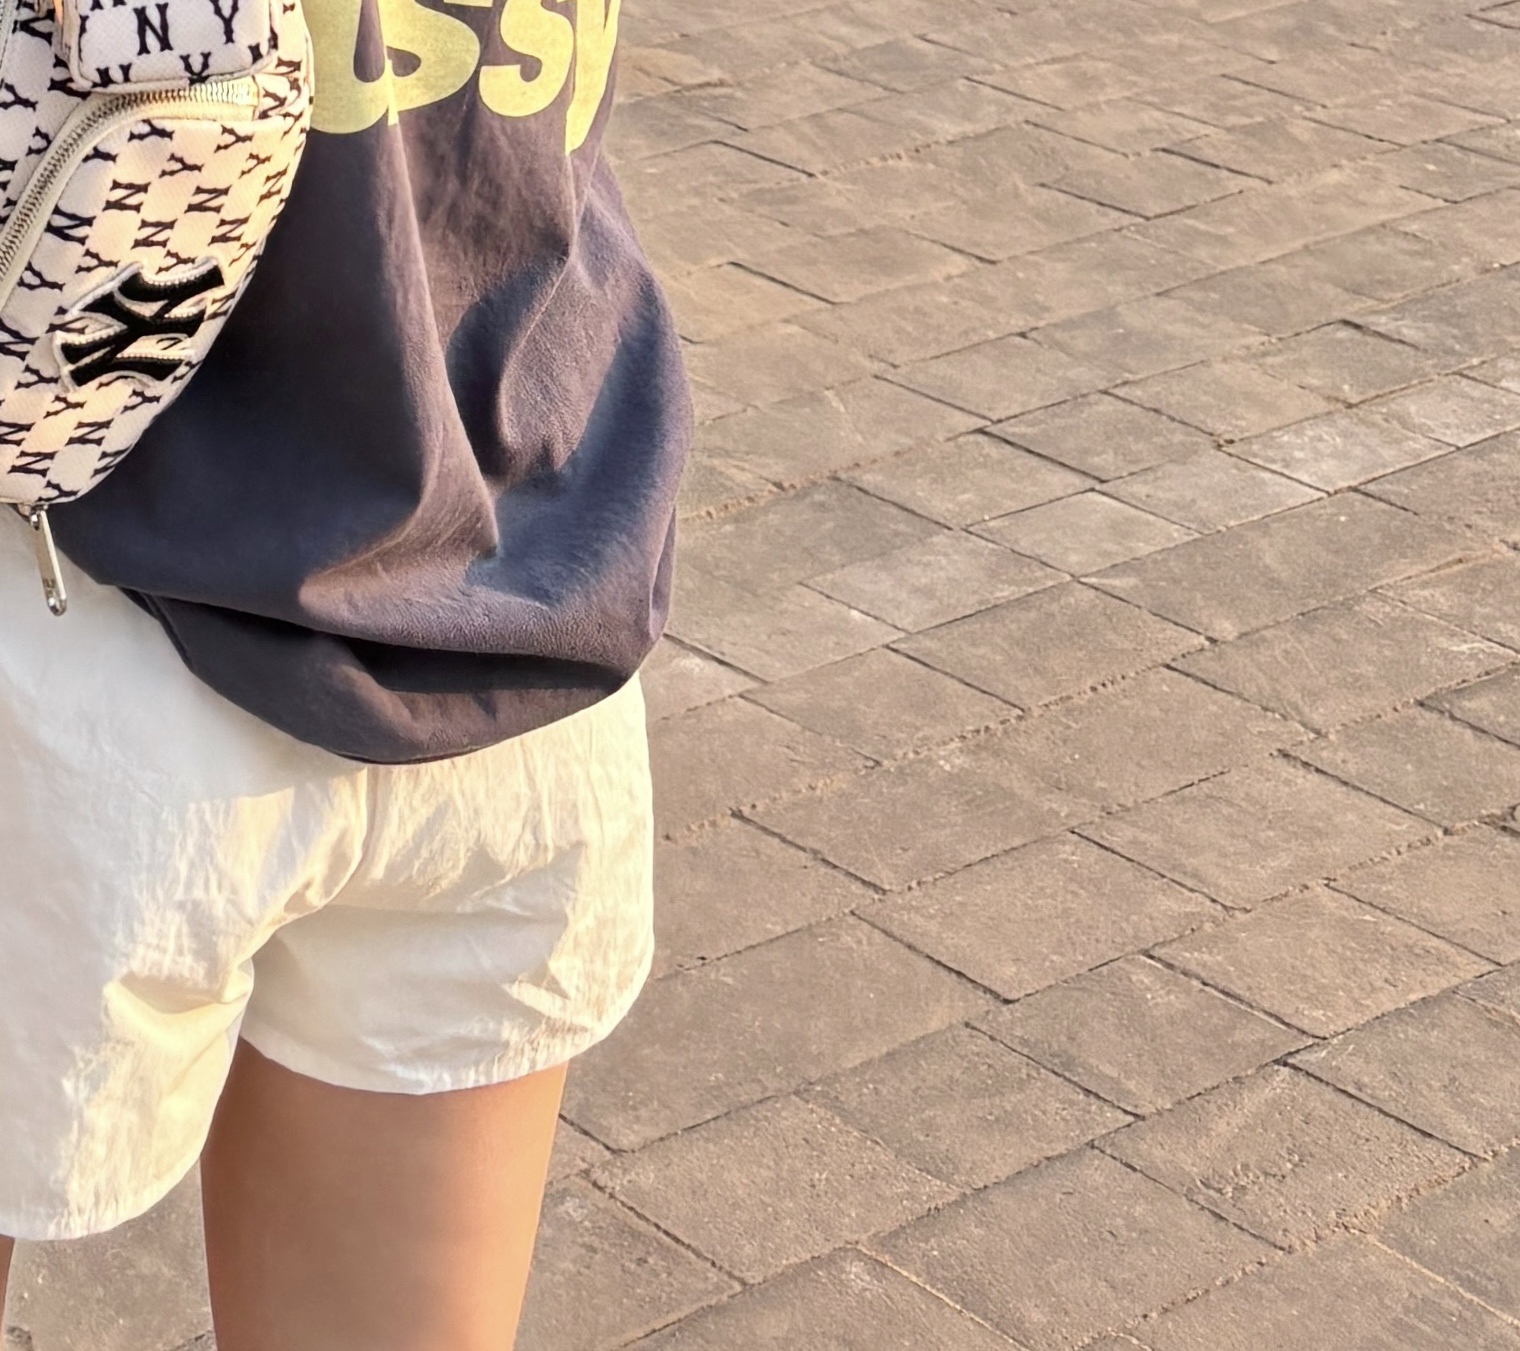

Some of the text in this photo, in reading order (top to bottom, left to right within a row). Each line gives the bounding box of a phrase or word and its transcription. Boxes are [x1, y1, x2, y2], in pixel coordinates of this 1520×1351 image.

[132, 2, 174, 57] N
[127, 118, 175, 143] Y
[214, 125, 253, 153] Y
[158, 153, 204, 179] Y
[240, 152, 272, 179] Y
[102, 179, 151, 214] N
[184, 185, 231, 214] N
[256, 167, 289, 206] N
[43, 203, 97, 247] N
[130, 218, 178, 250] N
[208, 216, 250, 246] N
[16, 260, 66, 292] Y
[74, 248, 120, 275] Y
[156, 249, 196, 275] Y
[56, 261, 227, 389] NY
[14, 363, 62, 390] Y
[43, 394, 86, 419] Y
[121, 388, 162, 414] Y
[65, 418, 114, 447] N
[7, 450, 58, 479] N
[34, 479, 80, 504] Y
